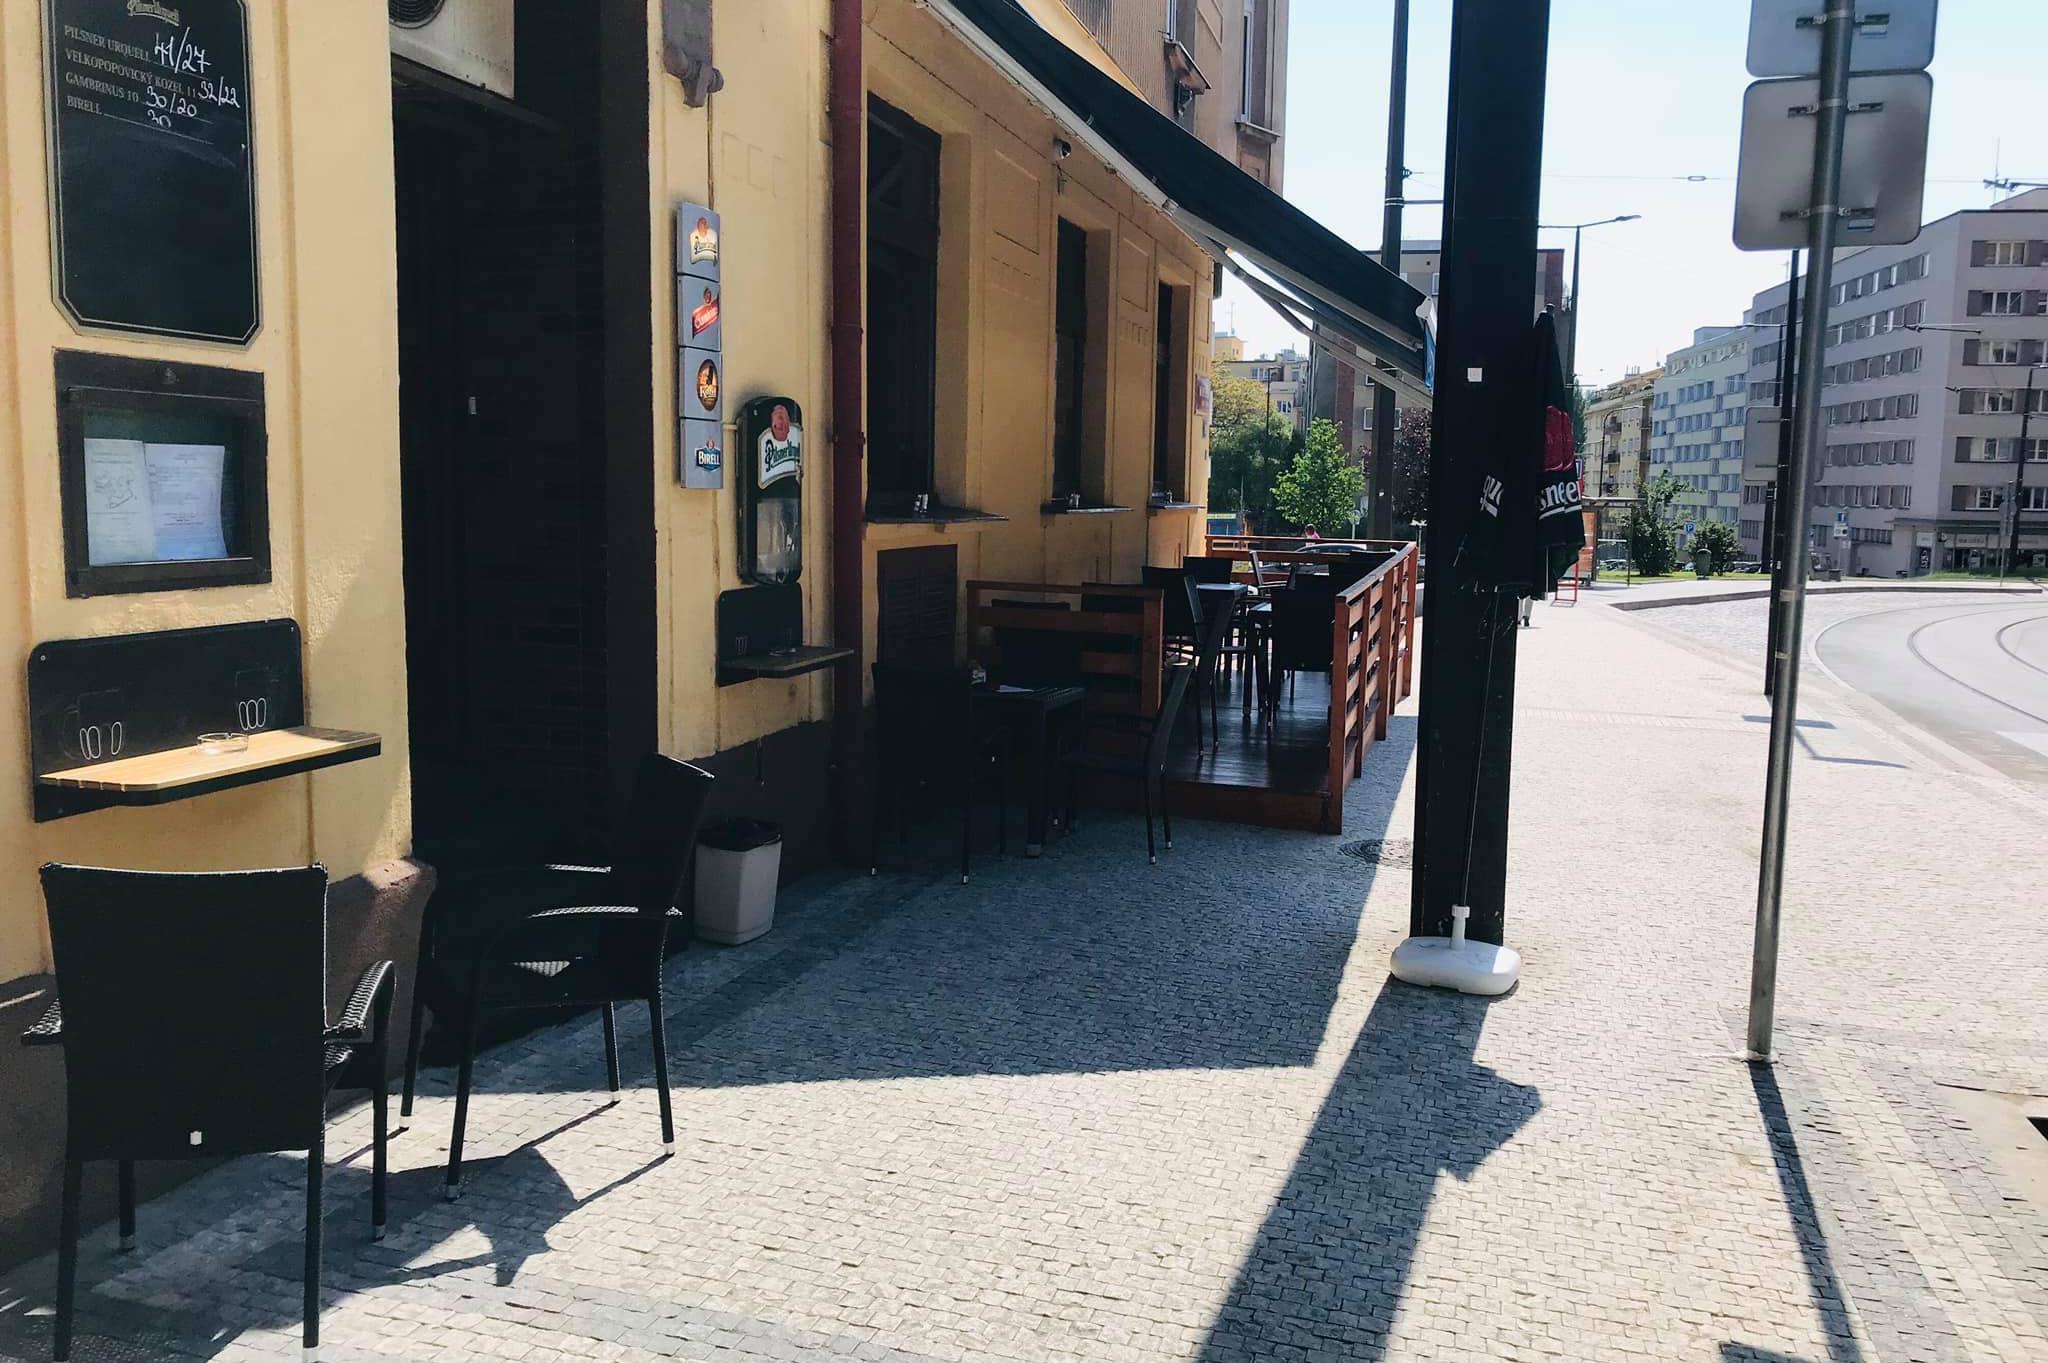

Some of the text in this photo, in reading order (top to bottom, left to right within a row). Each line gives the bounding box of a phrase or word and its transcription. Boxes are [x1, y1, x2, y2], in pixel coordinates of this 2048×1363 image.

[64, 25, 149, 62] PILSNER URQUELL
[65, 71, 125, 98] GAMBRINUS
[67, 95, 103, 115] BIRELL
